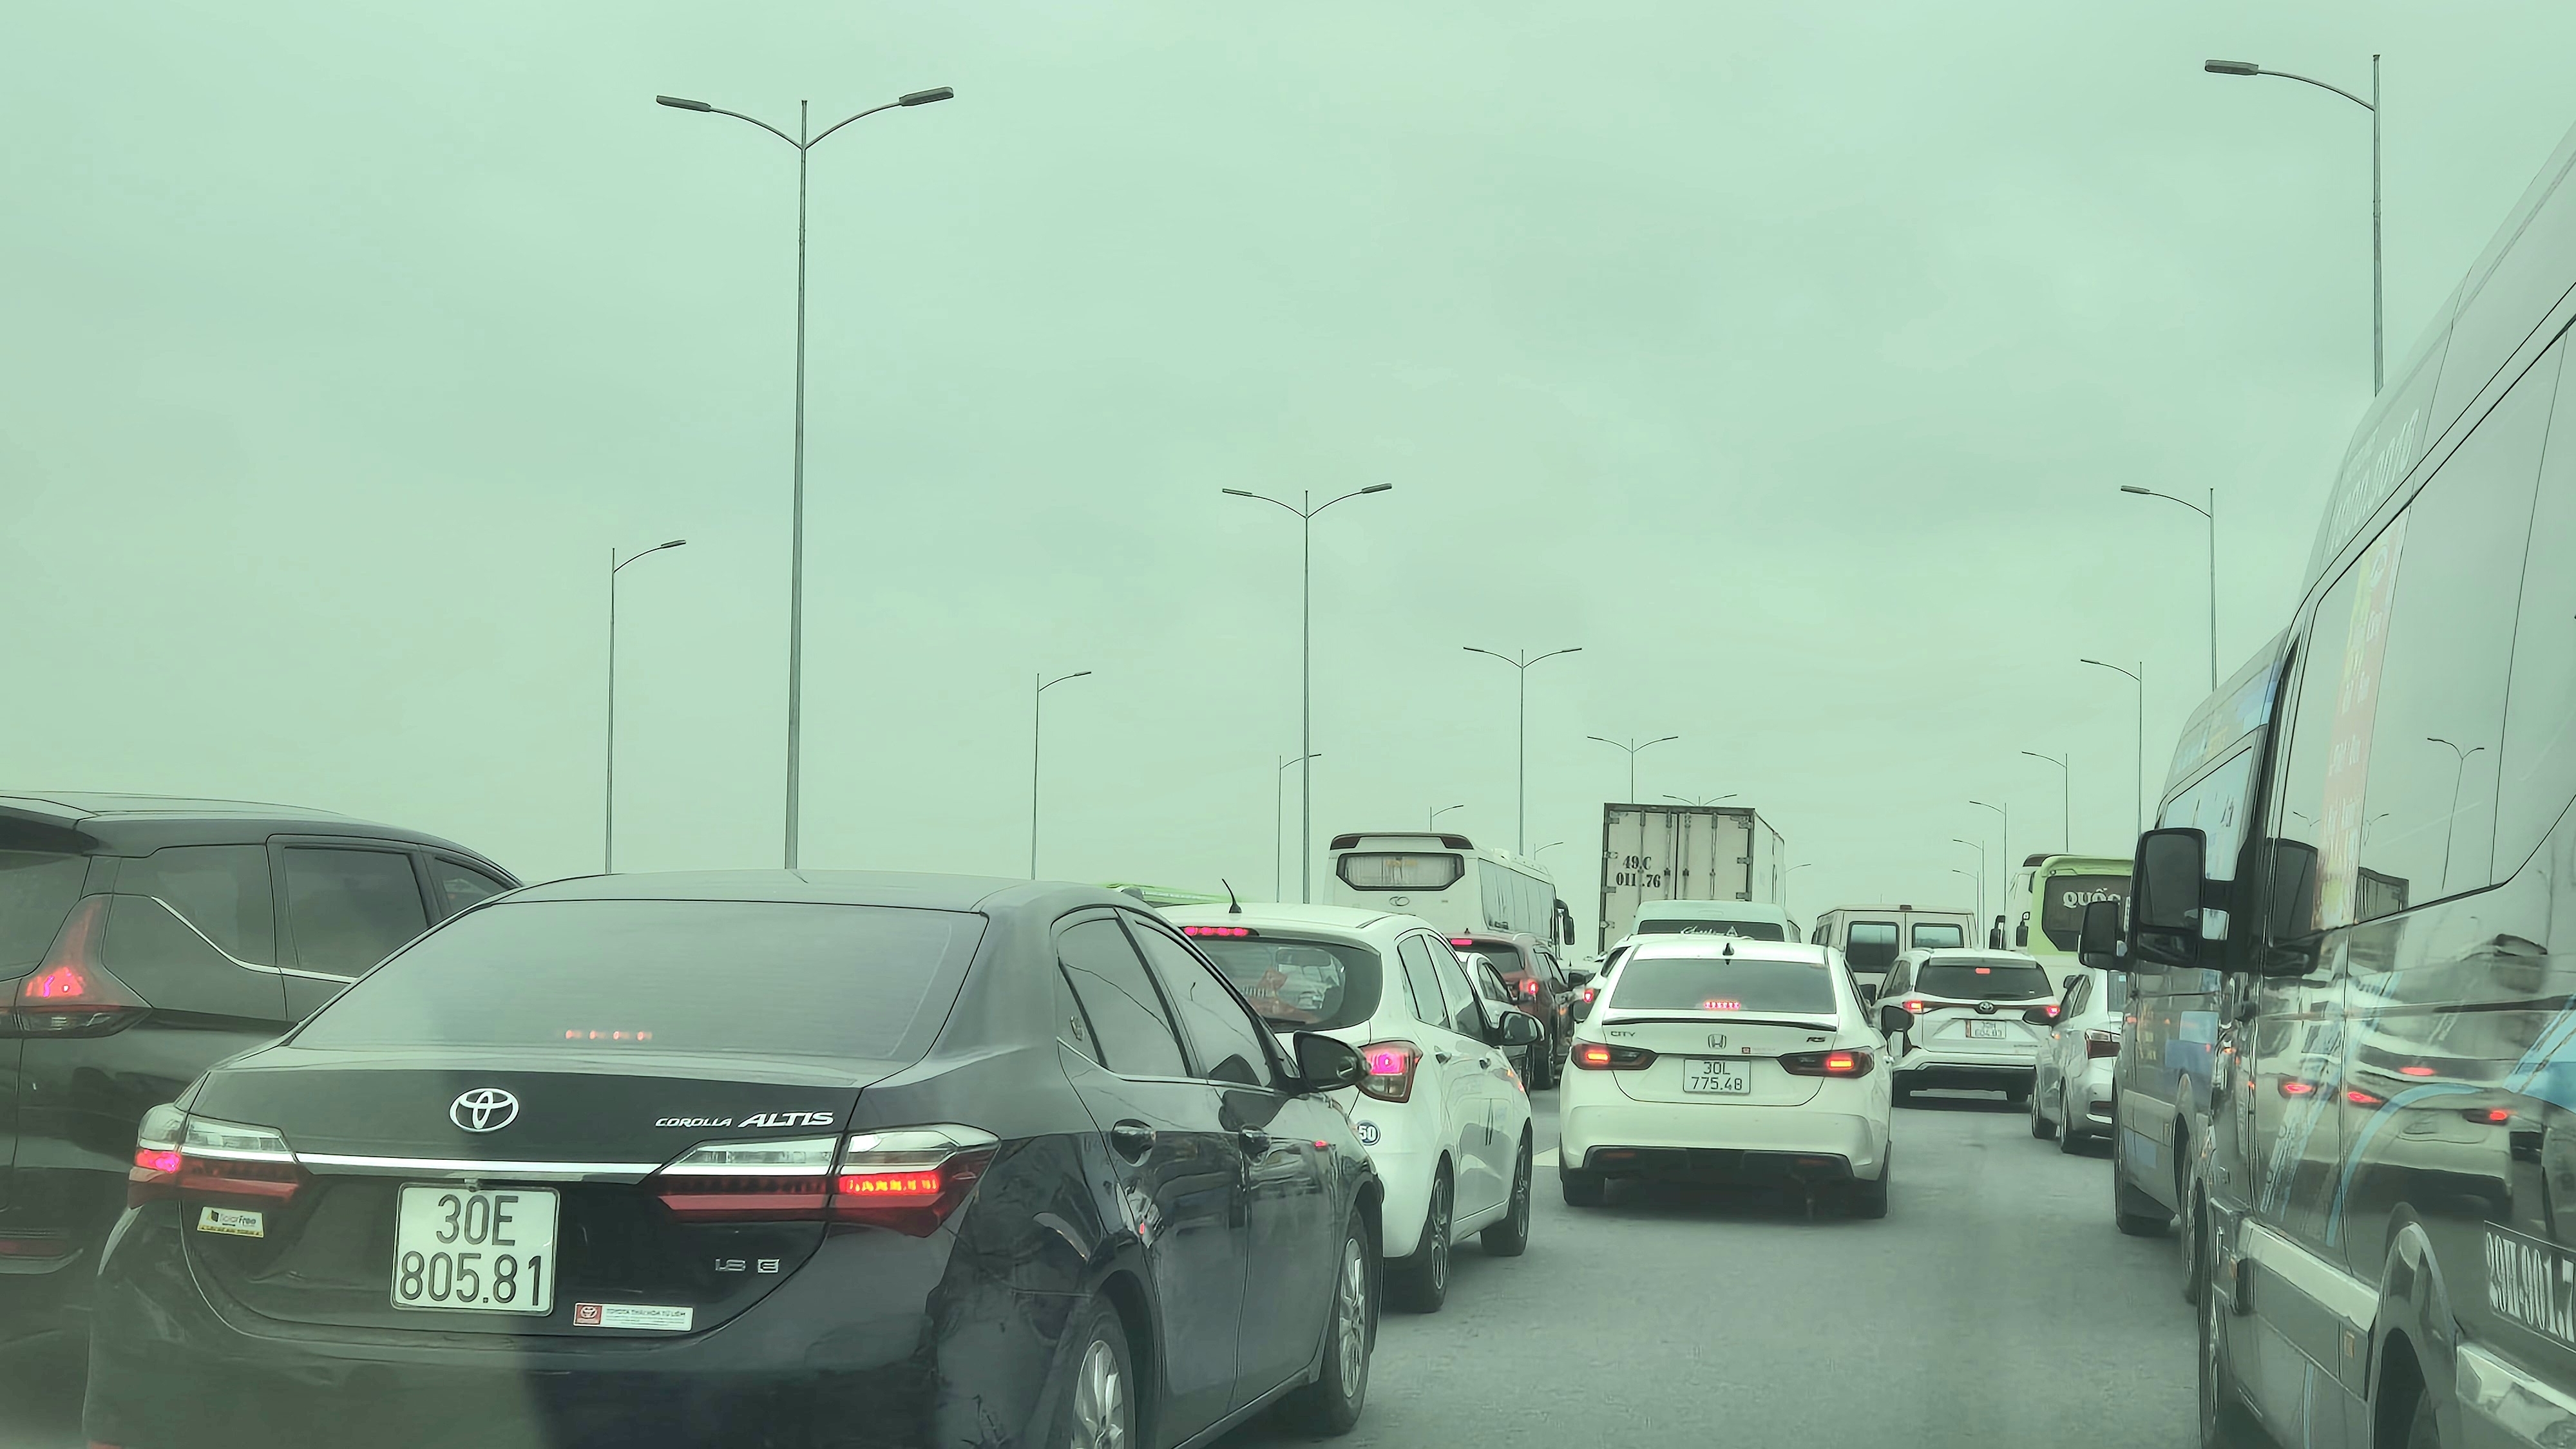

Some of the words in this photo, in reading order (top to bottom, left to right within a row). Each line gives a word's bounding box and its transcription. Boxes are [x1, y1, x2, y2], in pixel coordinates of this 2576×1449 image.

[1704, 1061, 1731, 1075] 30L
[1691, 1076, 1742, 1090] 775.48
[655, 1117, 732, 1128] COROLLA
[738, 1112, 834, 1128] ALTIS
[1359, 1124, 1378, 1142] 50
[435, 1193, 519, 1246] 30E
[400, 1251, 542, 1306] 805.81
